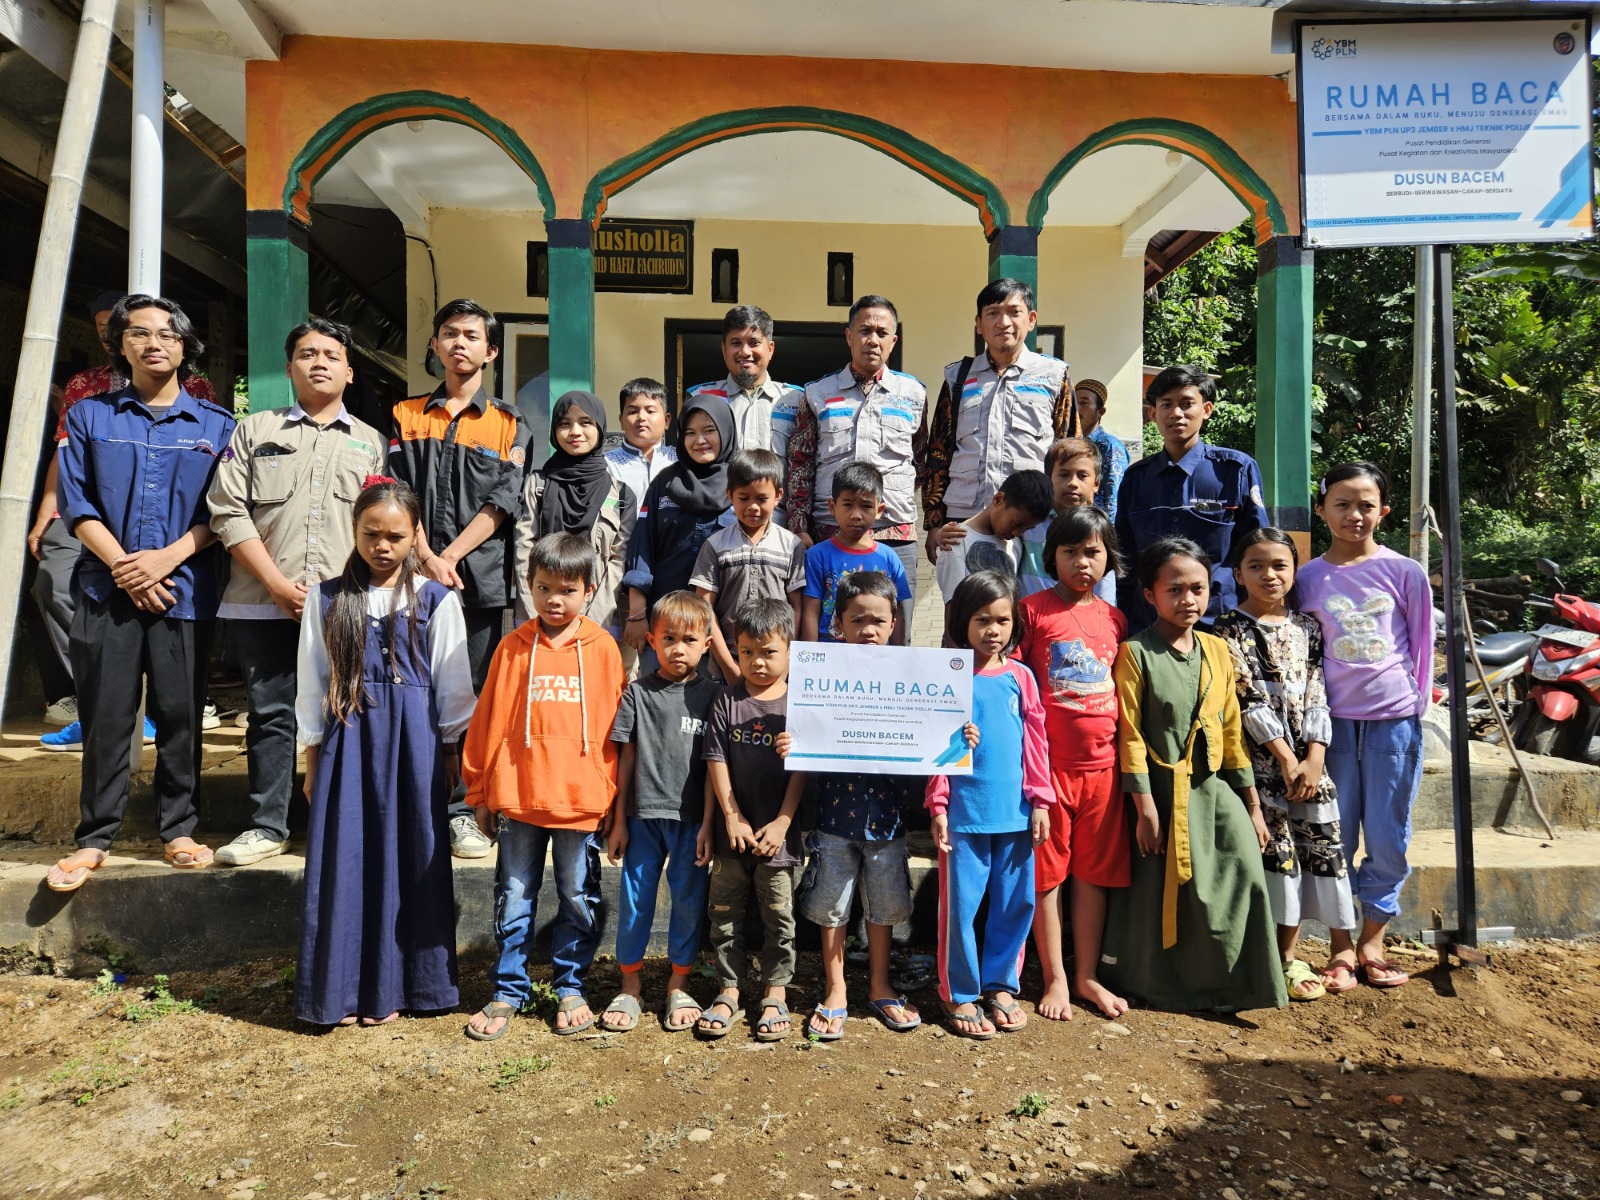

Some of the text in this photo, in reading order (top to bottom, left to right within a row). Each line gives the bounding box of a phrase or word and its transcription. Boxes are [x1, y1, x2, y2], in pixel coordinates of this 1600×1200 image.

[1334, 40, 1356, 48] YBM
[1327, 81, 1563, 108] RUMAH BACA
[1490, 109, 1537, 117] GENERASI
[1399, 150, 1428, 158] Kegiatan
[1480, 147, 1517, 156] Masyarakat
[1394, 171, 1504, 186] DUSUN BACEM
[594, 229, 684, 252] usholla
[610, 257, 634, 274] HAFIZ
[638, 258, 684, 275] FACHRUDIN
[532, 676, 580, 688] STAR
[804, 678, 954, 697] RUMAH BACA
[530, 689, 580, 702] WARS
[842, 731, 876, 739] DUSUN
